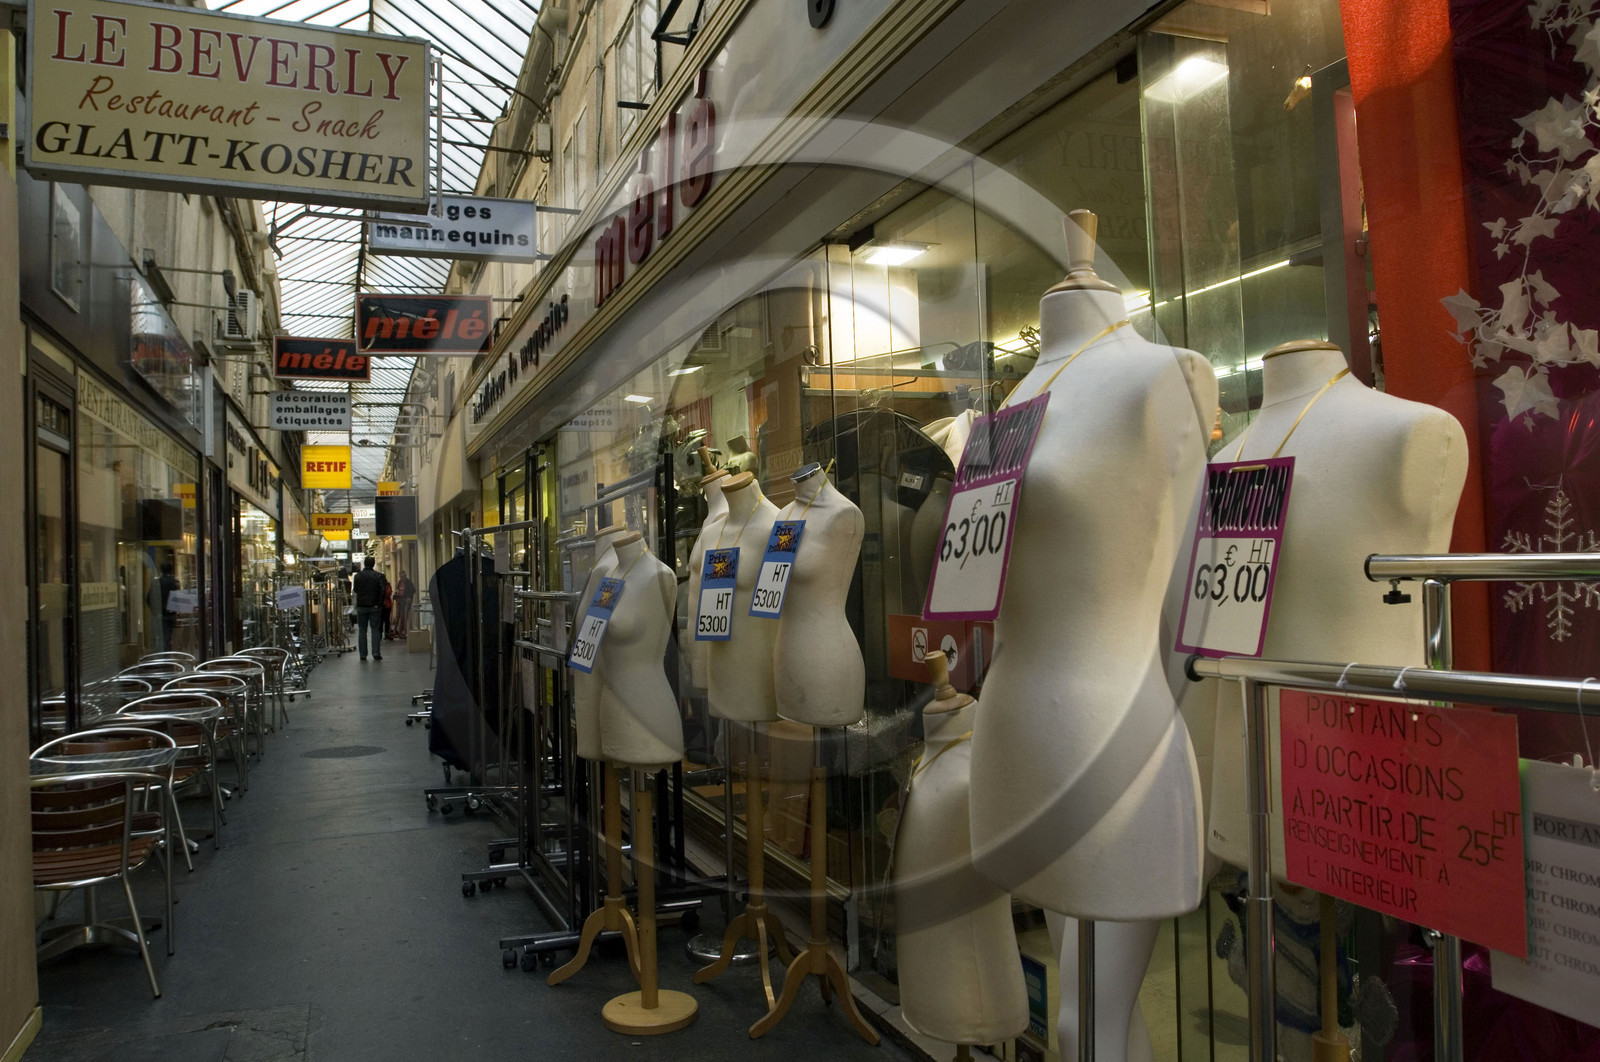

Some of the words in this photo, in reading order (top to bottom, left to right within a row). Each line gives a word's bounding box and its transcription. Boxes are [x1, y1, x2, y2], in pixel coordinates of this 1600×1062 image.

[51, 9, 128, 68] LE
[148, 22, 410, 101] BEVERLY
[78, 75, 260, 127] Restaurant
[291, 100, 384, 140] Snack
[35, 120, 416, 188] GLATT-KOSHER
[593, 69, 716, 309] mélé
[376, 224, 530, 248] mannequins
[276, 393, 347, 404] décoration
[276, 404, 347, 416] emballages
[276, 415, 343, 427] étiquettes
[305, 461, 347, 473] RETIF
[994, 480, 1015, 504] HT
[316, 517, 348, 527] RETIF
[940, 510, 1007, 571] 63,00
[1250, 538, 1274, 563] HT
[772, 563, 789, 583] HT
[1194, 563, 1271, 608] 63,00
[715, 592, 732, 610] HT
[753, 588, 782, 609] 5300
[588, 619, 604, 638] HT
[698, 614, 728, 633] 5300
[573, 639, 596, 661] 5300
[1306, 694, 1443, 747] PORTANTS
[1491, 809, 1520, 838] HT
